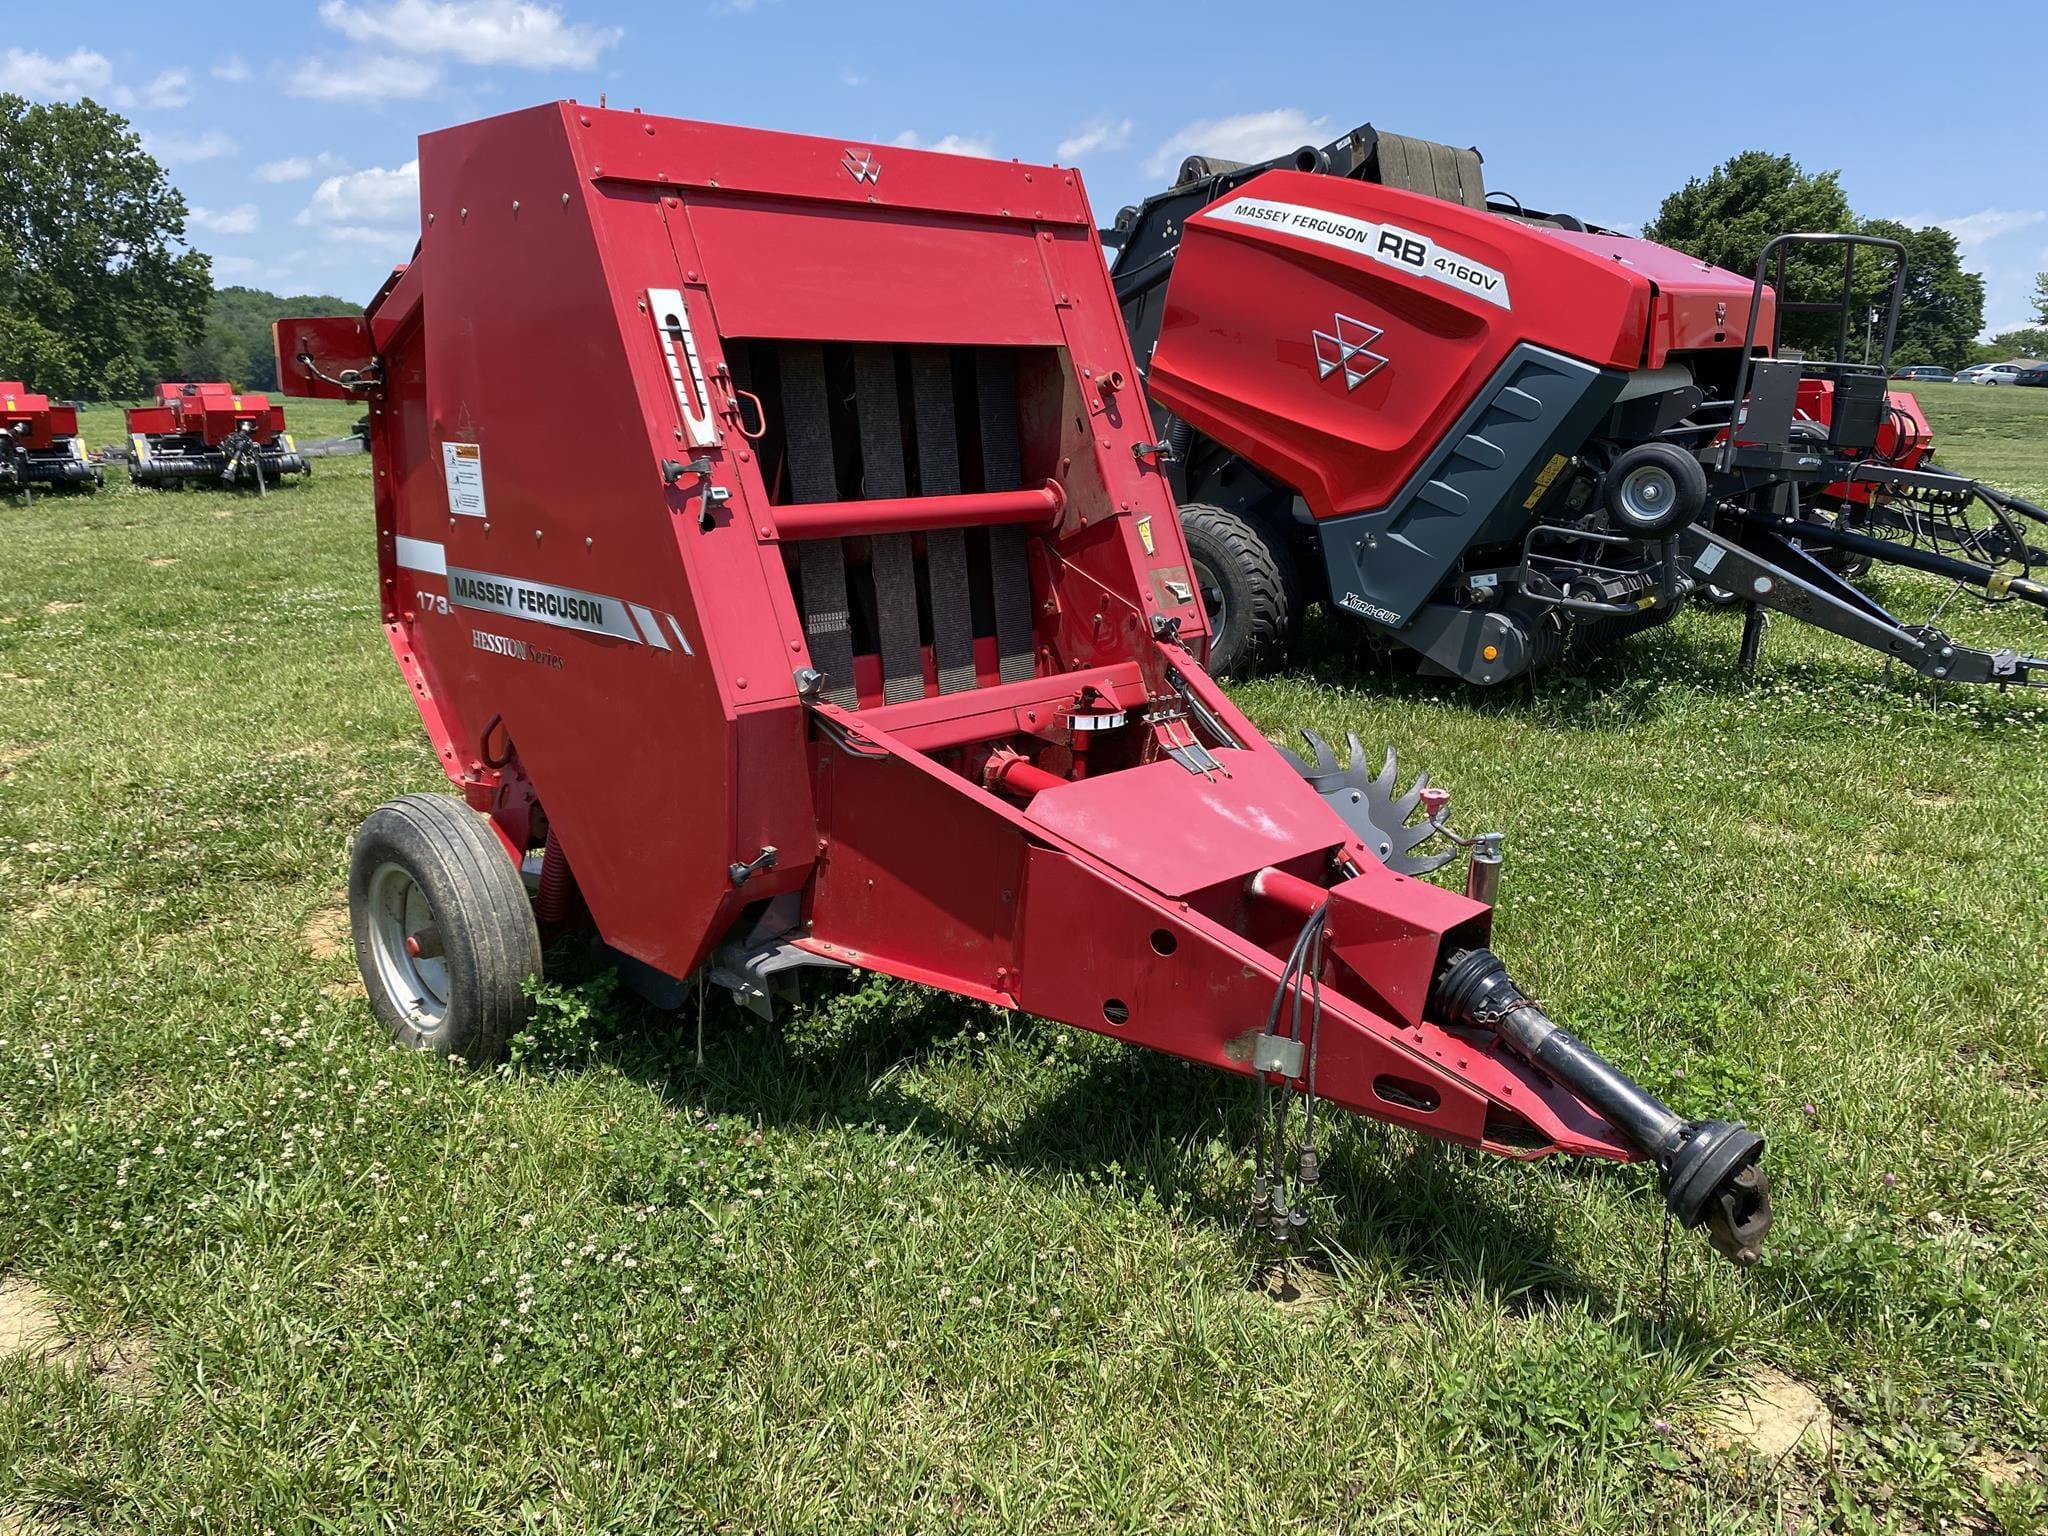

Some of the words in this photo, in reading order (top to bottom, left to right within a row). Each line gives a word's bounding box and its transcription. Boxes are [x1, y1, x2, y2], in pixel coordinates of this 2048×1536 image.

[1234, 204, 1290, 224] MASSEY
[1292, 214, 1368, 243] FERGUSON
[1378, 231, 1428, 267] RB
[1433, 257, 1499, 291] 4160V
[416, 591, 454, 615] 173
[454, 577, 513, 607] MASSEY
[518, 588, 603, 625] FERGUSON
[472, 629, 527, 661] HESSTON
[528, 645, 564, 671] Series
